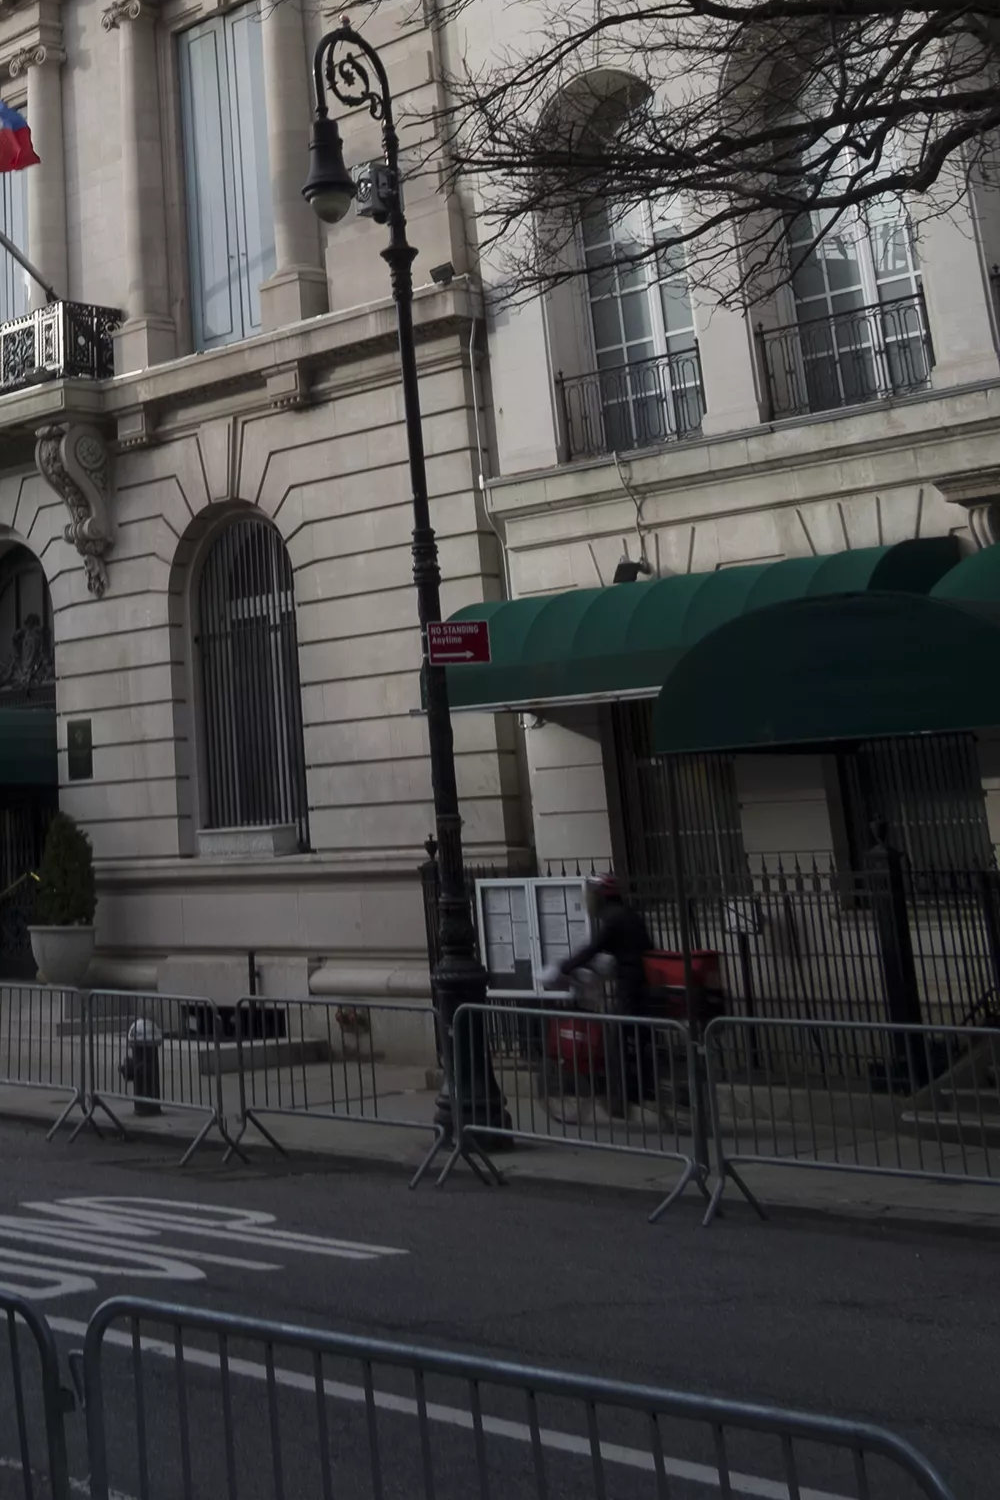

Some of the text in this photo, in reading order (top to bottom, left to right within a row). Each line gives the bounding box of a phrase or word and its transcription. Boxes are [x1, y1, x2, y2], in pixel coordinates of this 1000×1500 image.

[431, 625, 479, 635] NO STANDING
[432, 636, 462, 646] Anytime
